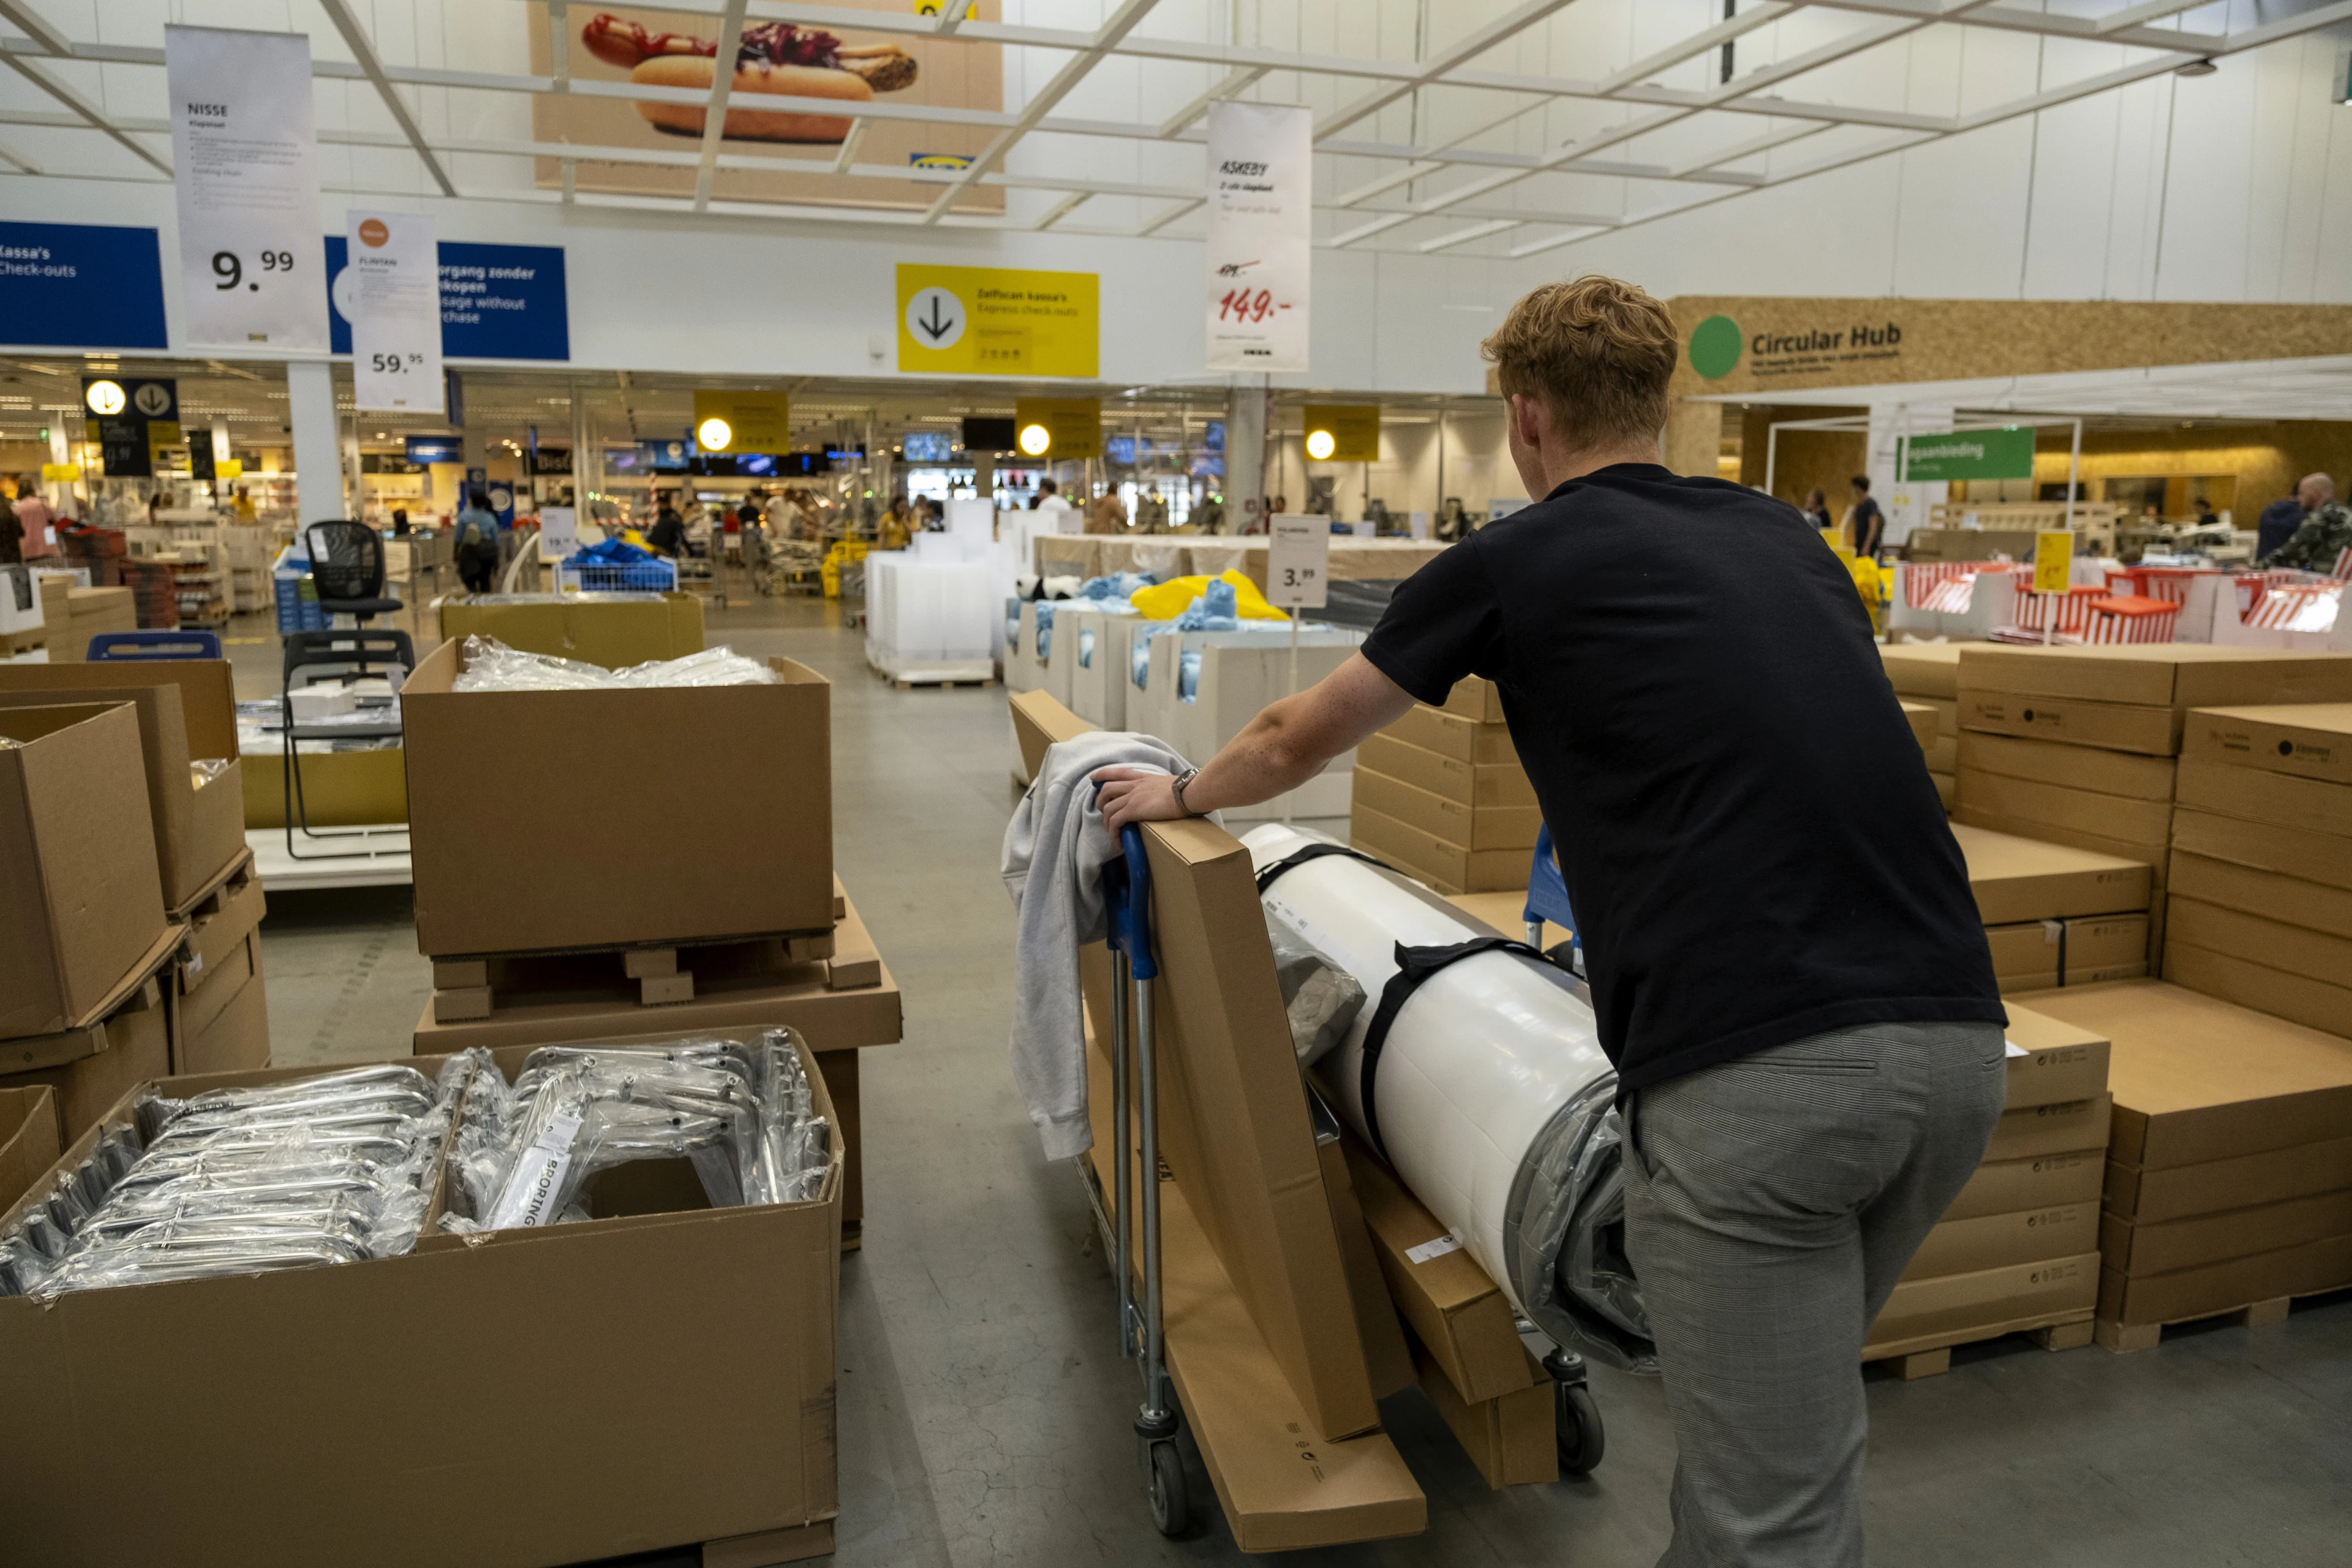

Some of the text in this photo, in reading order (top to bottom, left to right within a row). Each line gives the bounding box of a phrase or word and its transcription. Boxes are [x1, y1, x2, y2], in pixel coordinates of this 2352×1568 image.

[187, 102, 228, 117] NISSE
[1219, 160, 1268, 177] ASKEBY
[212, 249, 294, 293] 9.99
[488, 265, 536, 281] zonder
[1219, 287, 1292, 323] 149.-
[1752, 321, 1901, 355] Circular Hub
